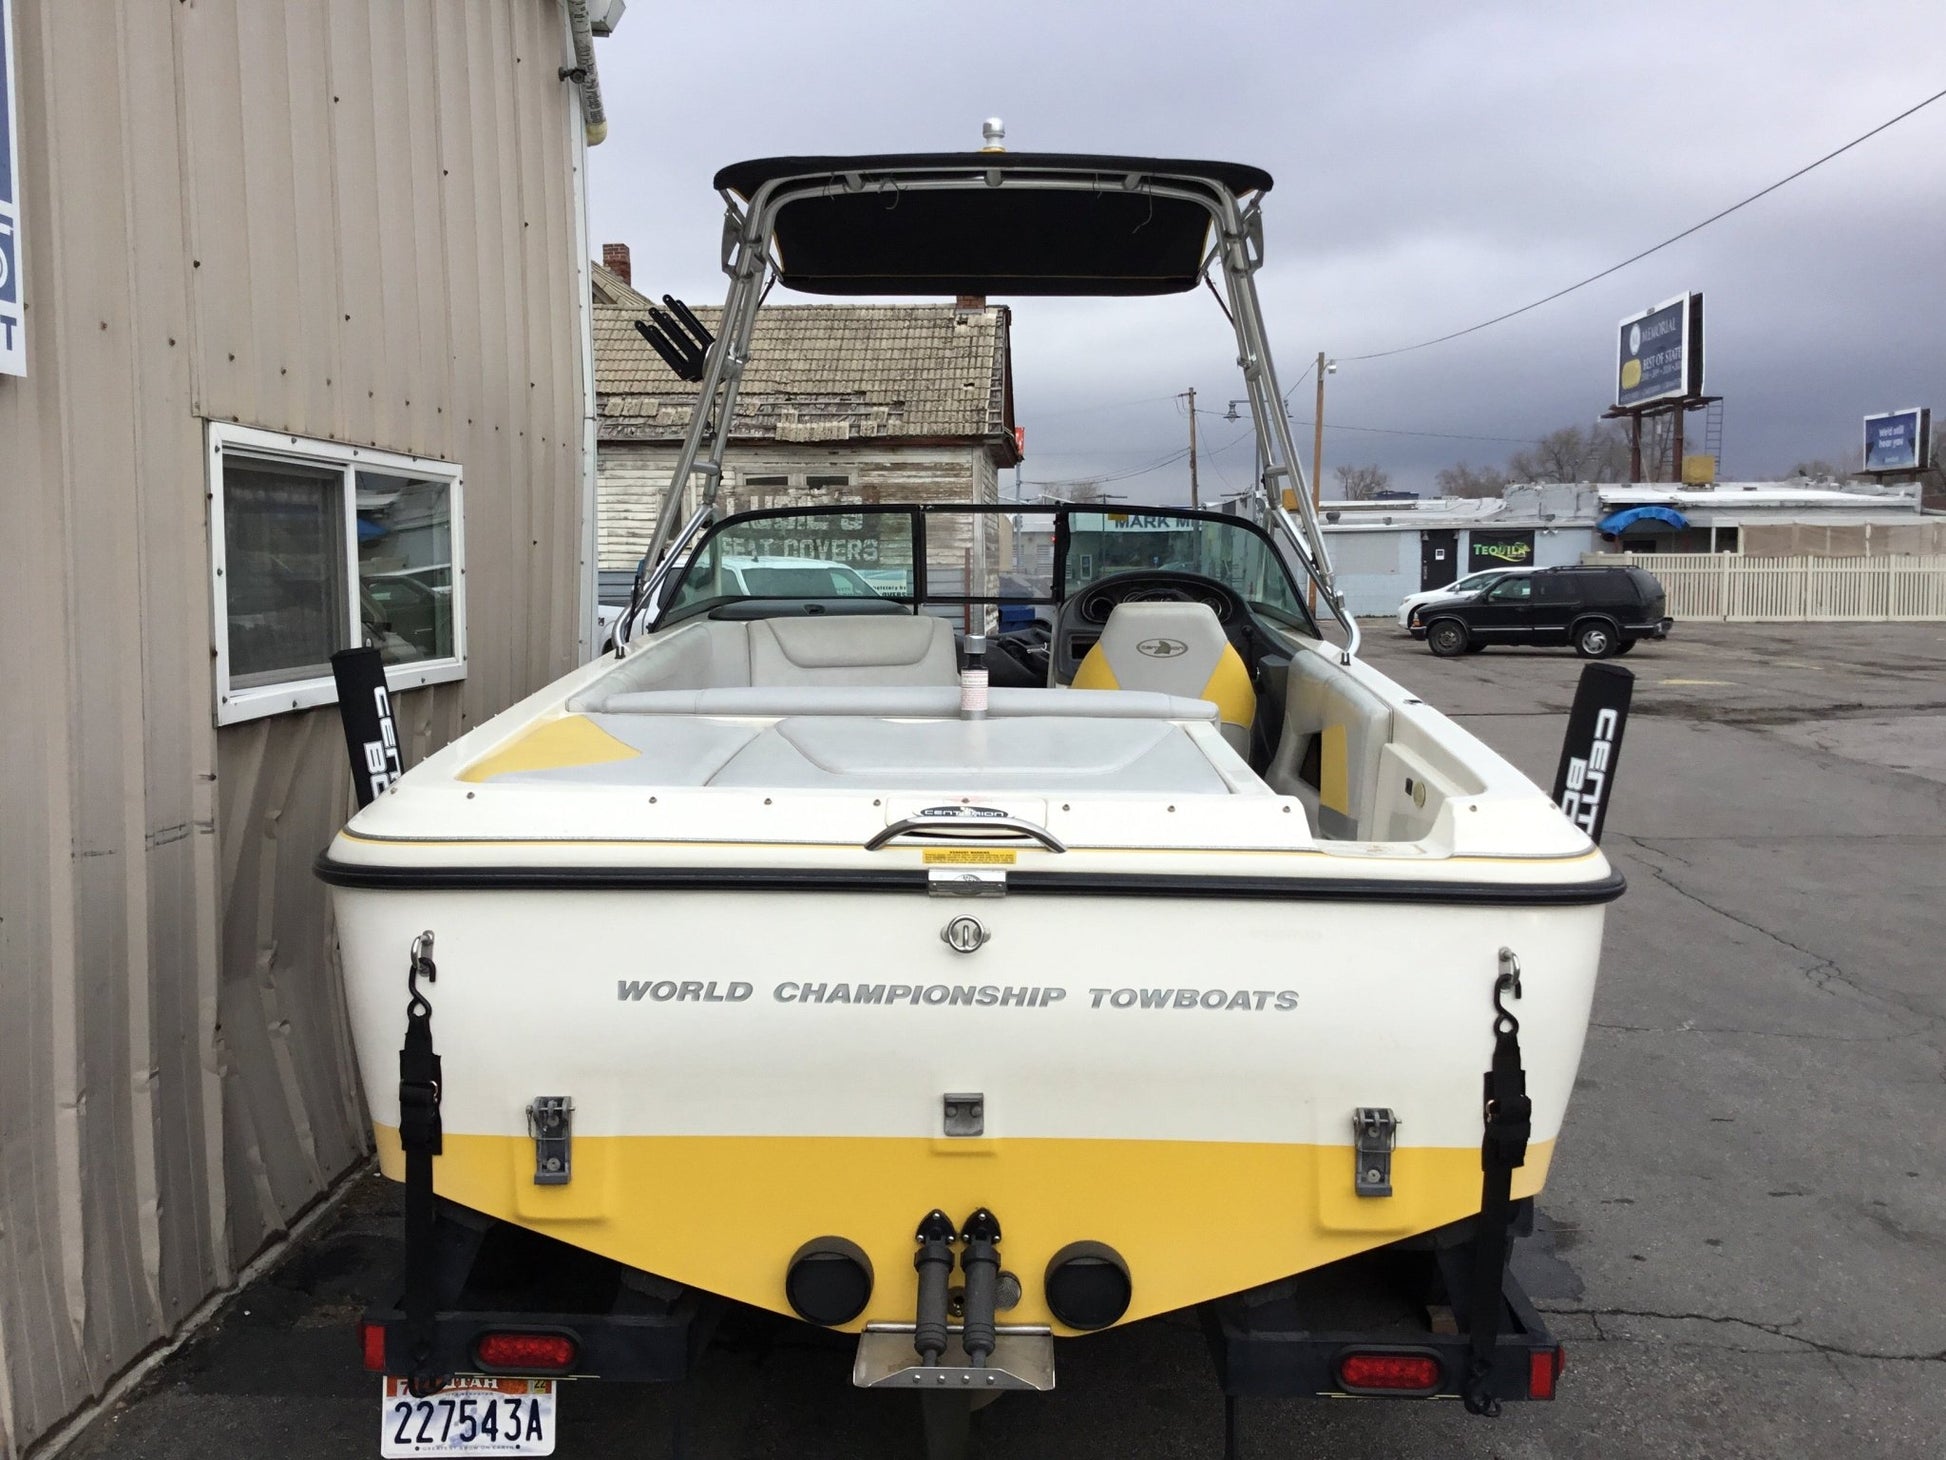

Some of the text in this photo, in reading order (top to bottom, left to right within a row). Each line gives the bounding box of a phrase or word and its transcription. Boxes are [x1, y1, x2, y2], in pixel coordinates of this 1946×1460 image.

[1641, 317, 1676, 344] MEMORIAL
[1656, 352, 1664, 366] OF
[784, 538, 878, 561] COVERS
[617, 980, 1299, 1012] WORLD CHAMPIONSHIP TOWBOATS
[394, 1398, 543, 1444] 227543A
